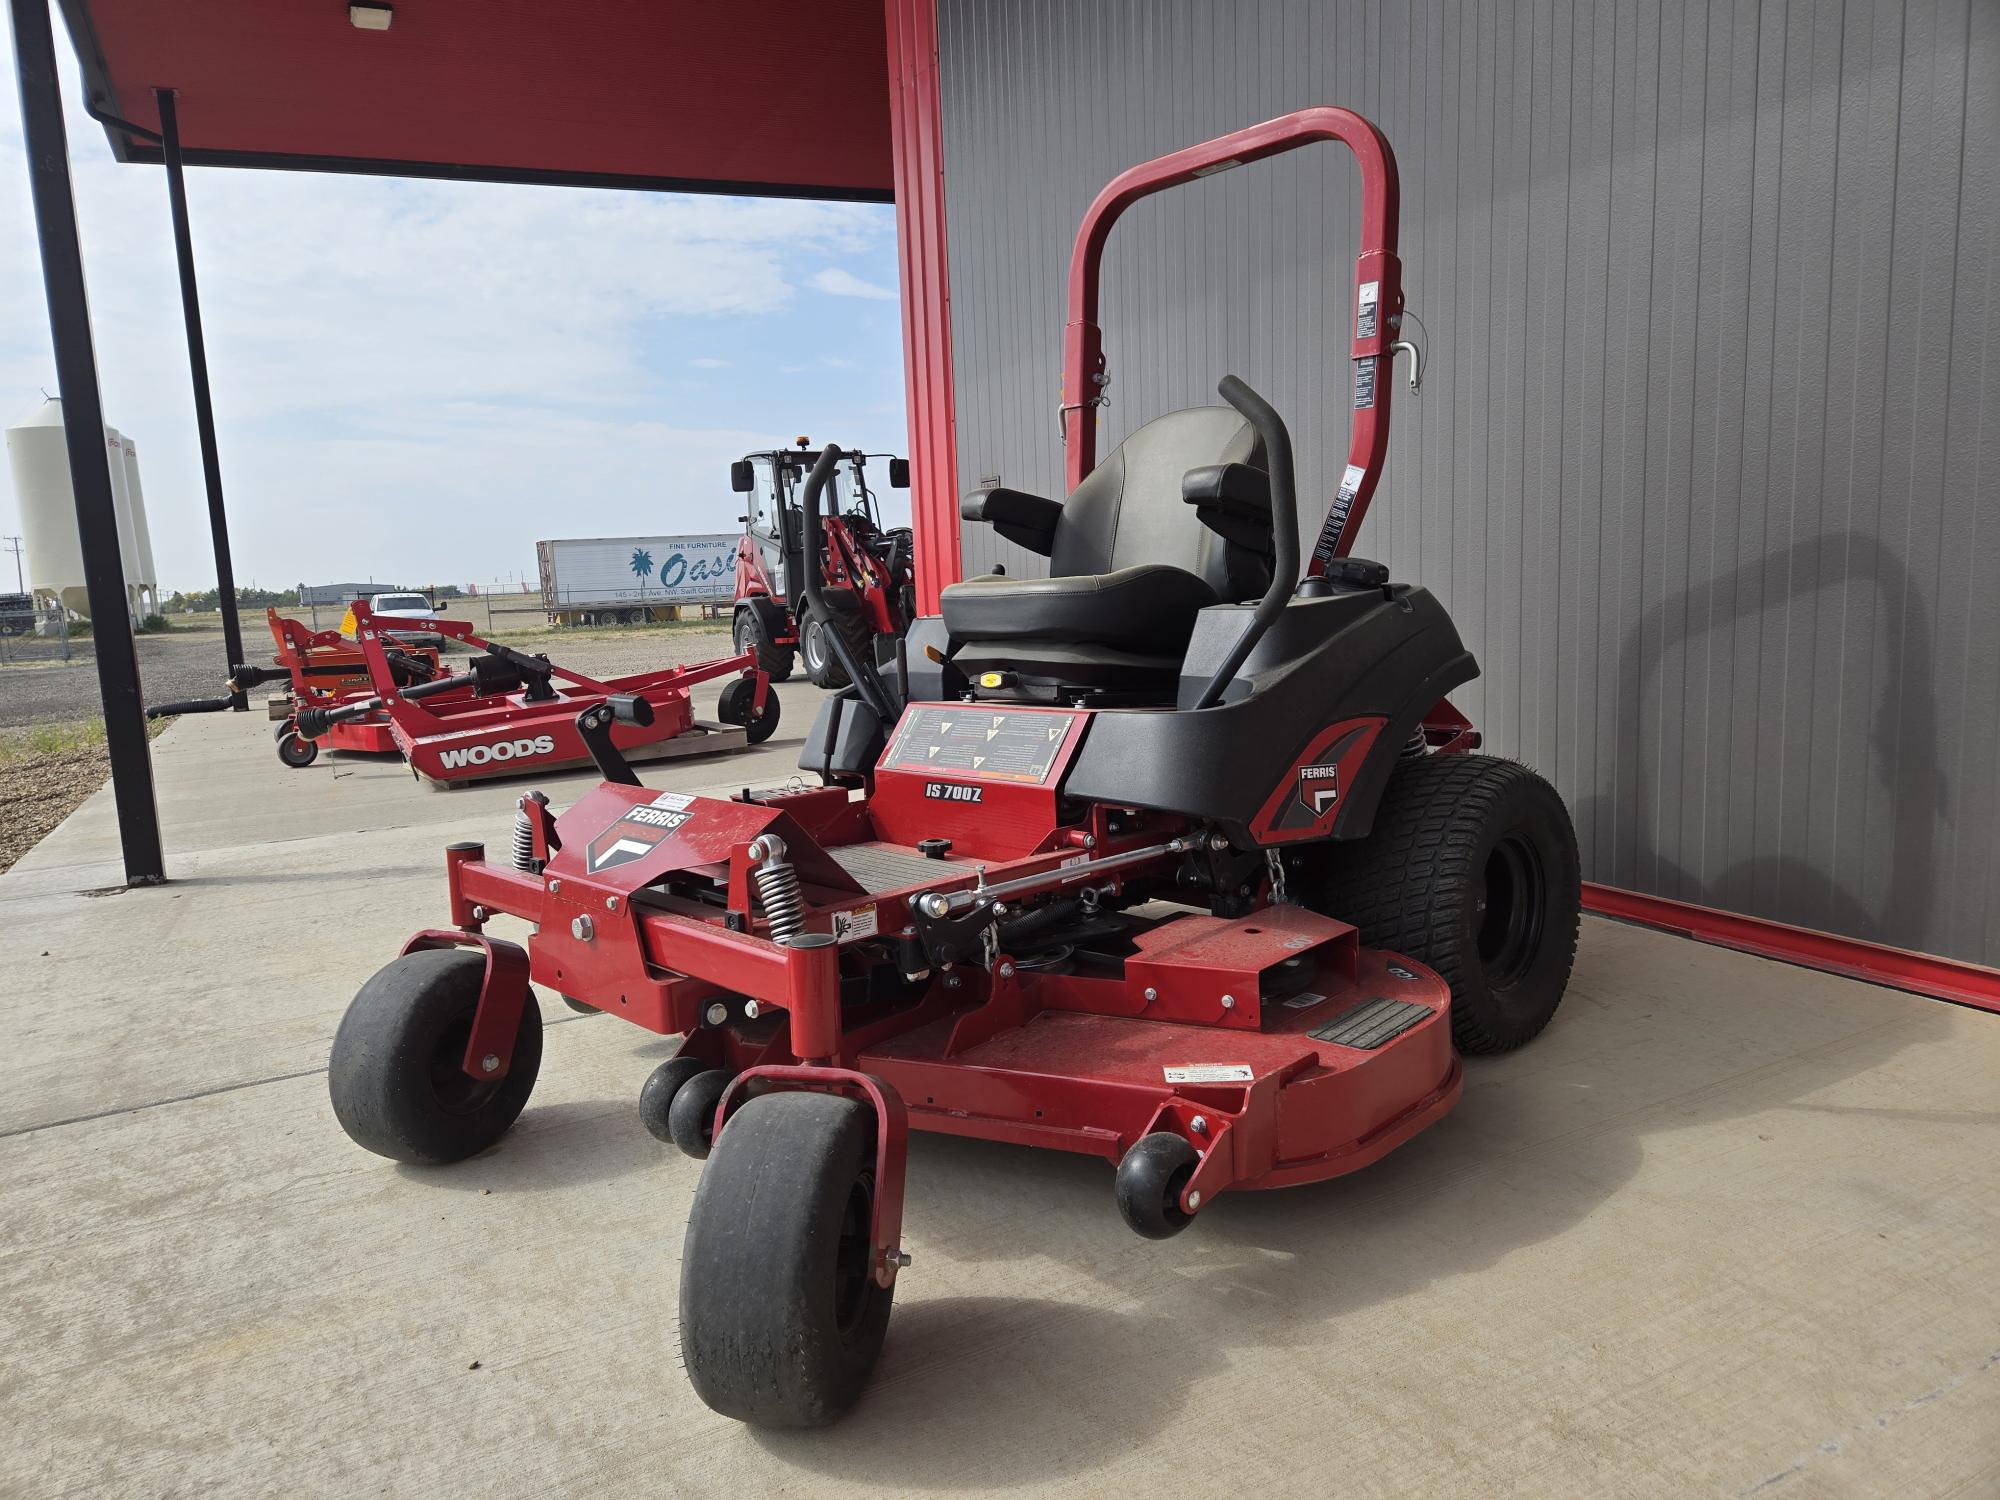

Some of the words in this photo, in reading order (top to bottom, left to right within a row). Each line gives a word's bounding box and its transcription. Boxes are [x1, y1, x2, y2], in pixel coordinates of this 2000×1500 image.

[660, 547, 737, 588] Oasi
[681, 587, 697, 595] Swift
[439, 735, 555, 769] WOODS
[1301, 767, 1335, 779] FERRIS
[926, 783, 941, 798] IS
[943, 785, 982, 802] 700Z
[625, 806, 686, 828] FERRIS
